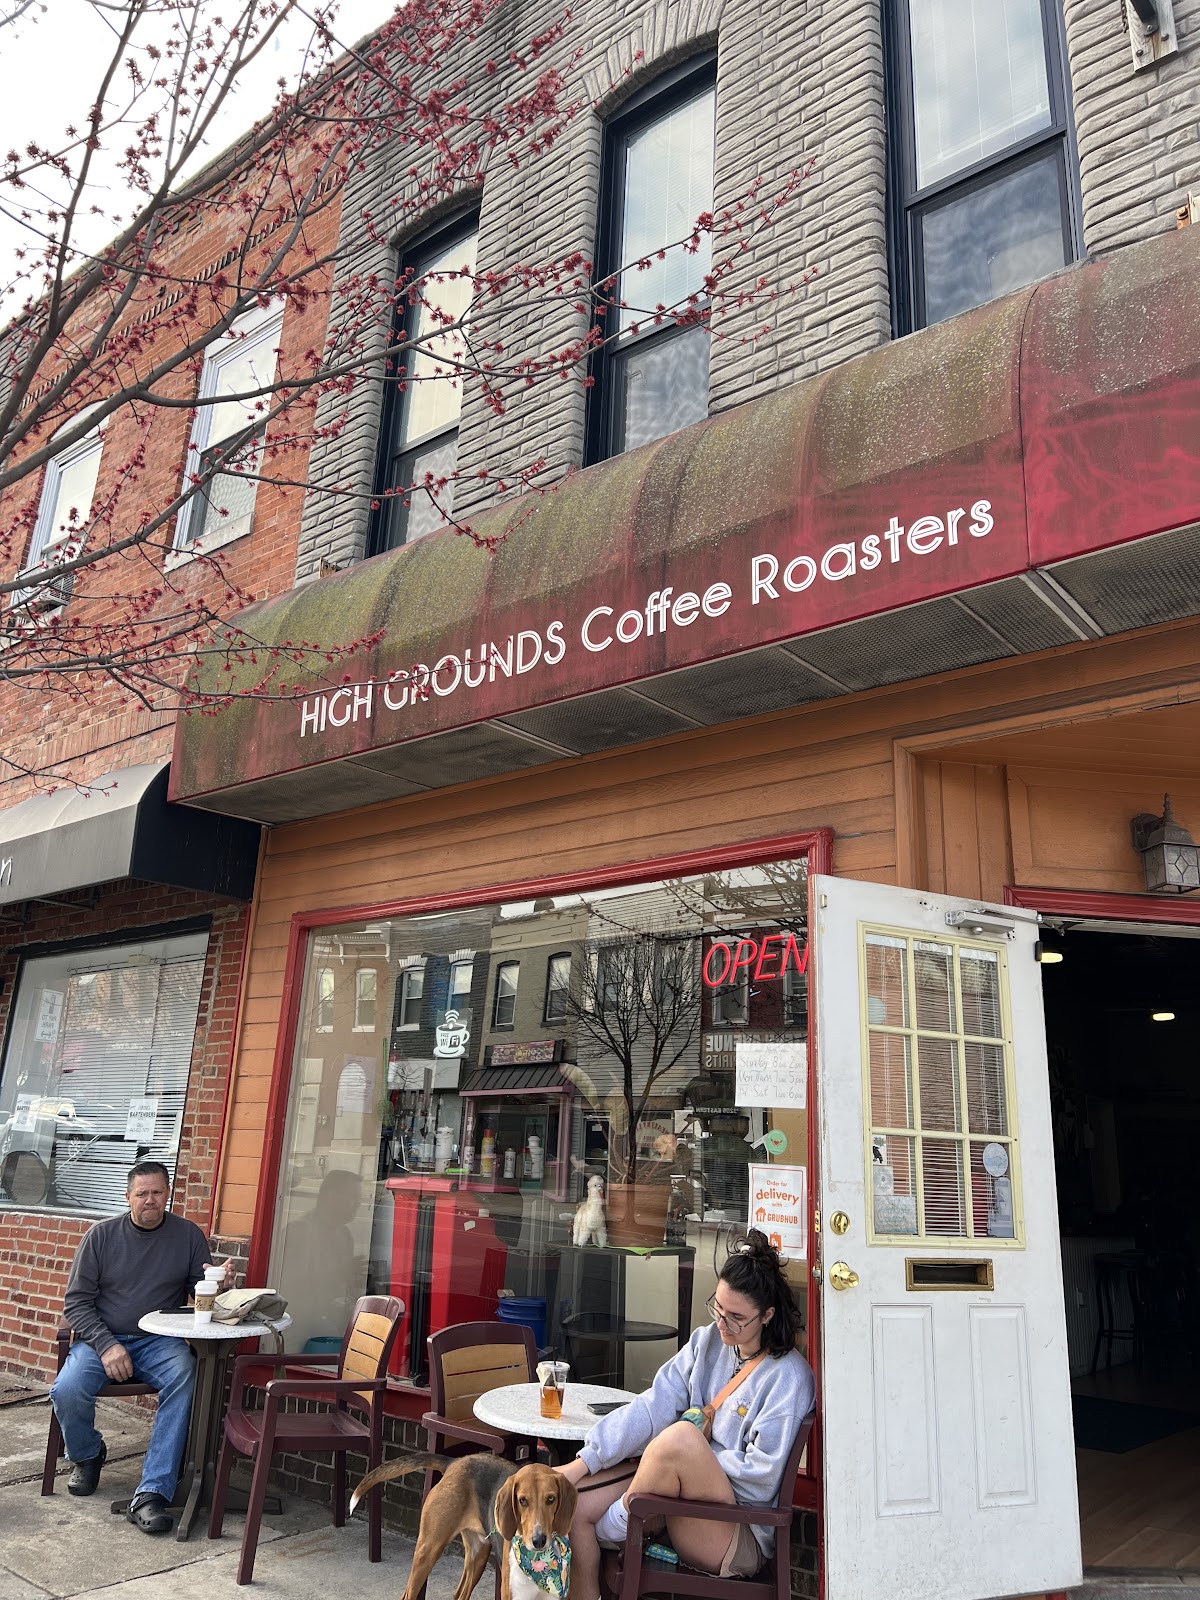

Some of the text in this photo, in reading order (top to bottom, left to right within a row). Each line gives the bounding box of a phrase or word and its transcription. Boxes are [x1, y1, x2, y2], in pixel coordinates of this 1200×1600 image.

[300, 498, 995, 737] HIGH GROUNDS Coffee Roasters
[703, 933, 809, 987] OPEN
[756, 1188, 799, 1205] delivery
[767, 1213, 798, 1224] GRUBHUB
